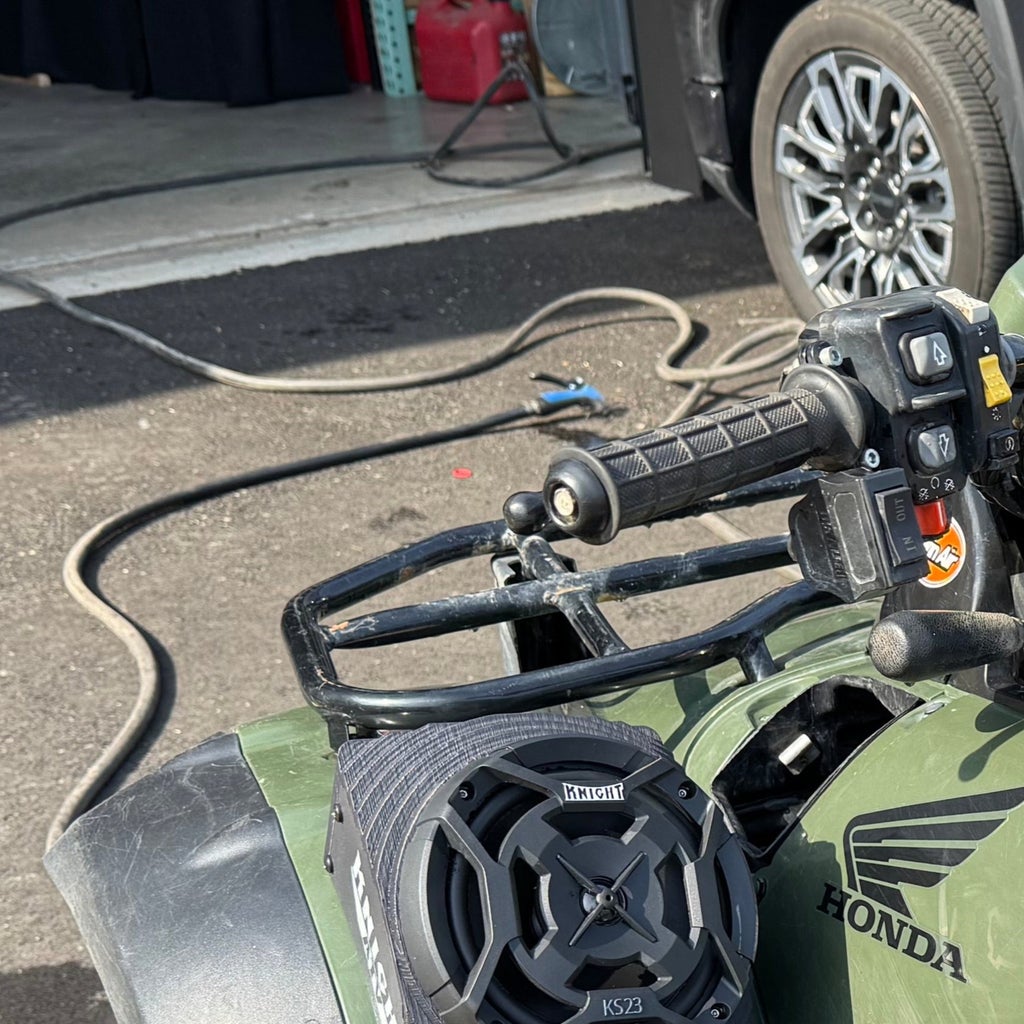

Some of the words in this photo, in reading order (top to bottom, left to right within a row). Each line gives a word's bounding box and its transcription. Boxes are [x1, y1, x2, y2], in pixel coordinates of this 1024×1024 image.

[894, 497, 906, 522] OUT
[902, 535, 917, 552] IN
[564, 783, 624, 800] KNIGHT
[816, 882, 968, 984] HONDA
[602, 996, 643, 1017] KS23
